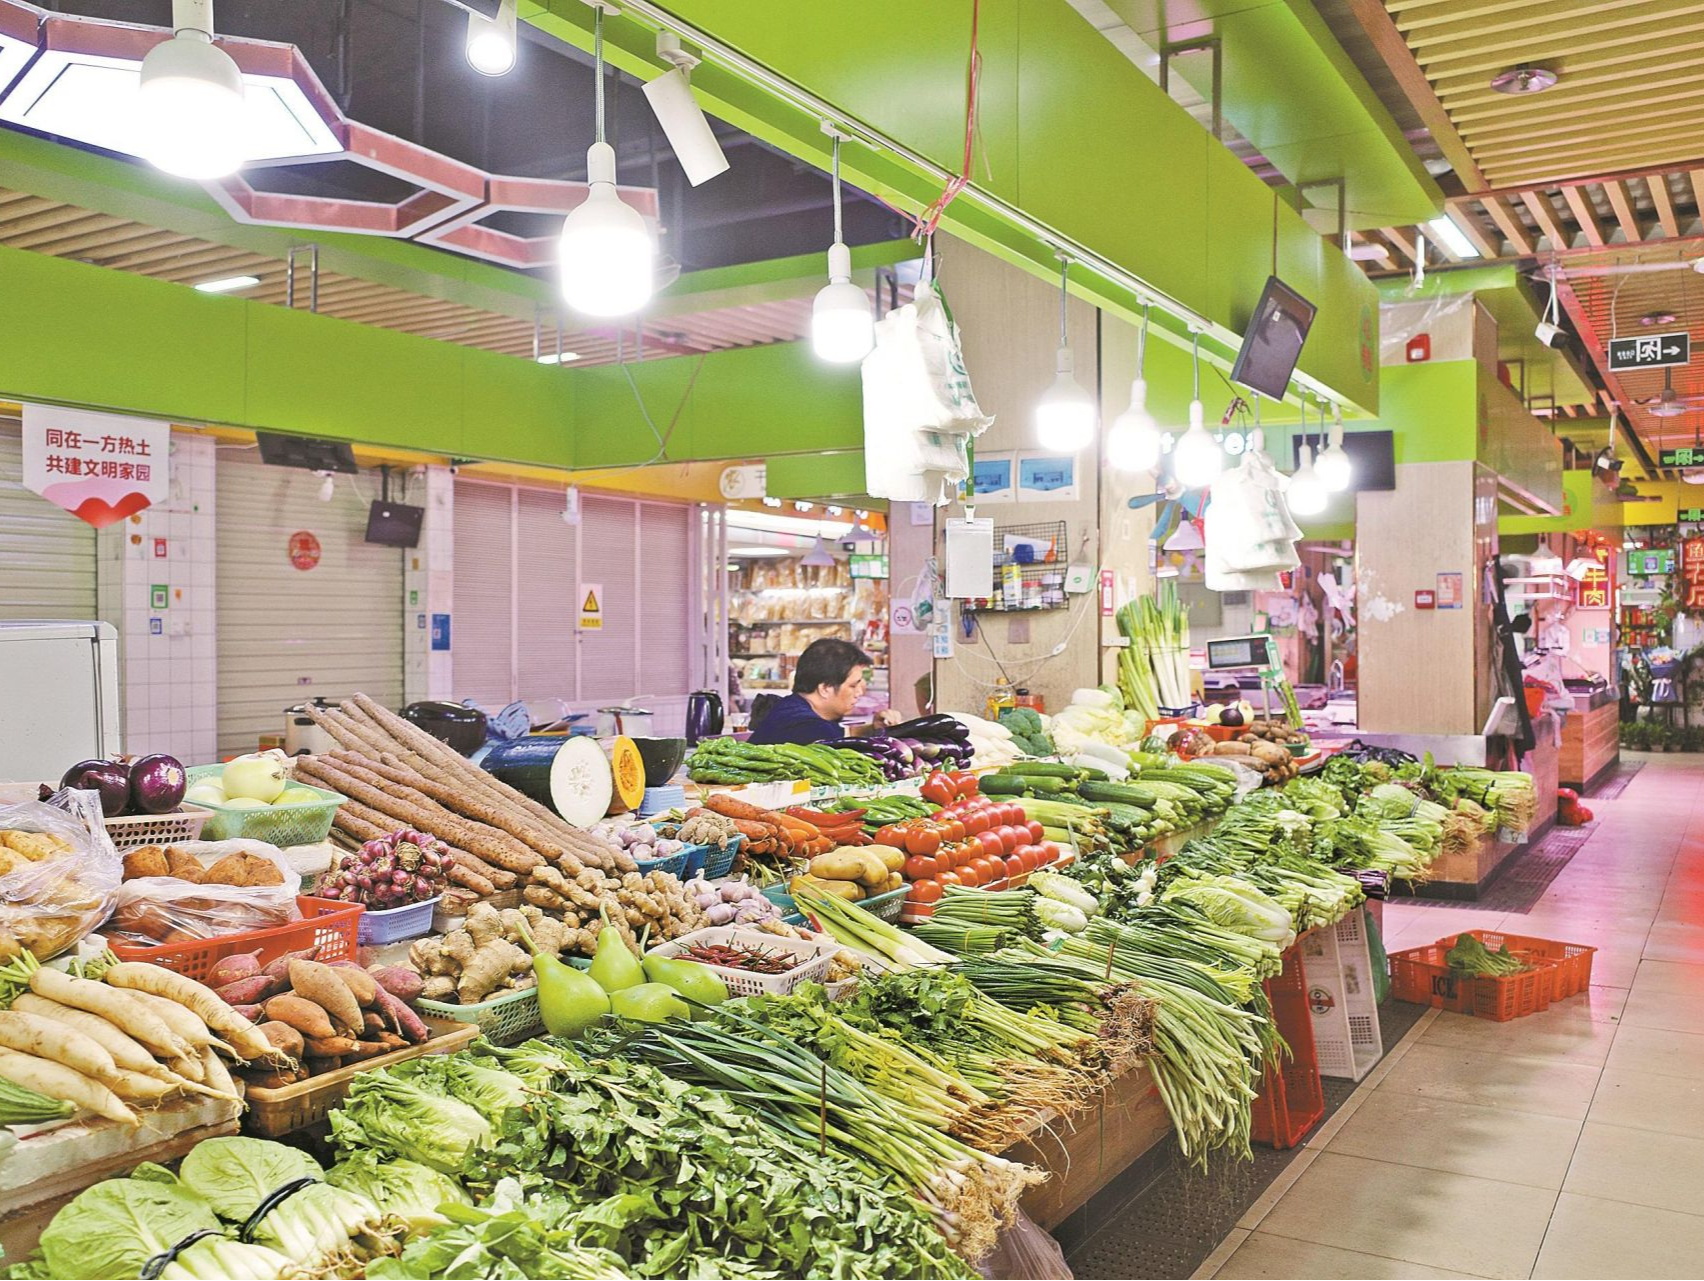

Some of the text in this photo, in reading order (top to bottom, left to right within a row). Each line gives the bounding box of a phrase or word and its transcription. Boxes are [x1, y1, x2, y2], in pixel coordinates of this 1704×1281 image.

[46, 428, 151, 457] 同在一方热土
[46, 454, 151, 482] 共建文明家园
